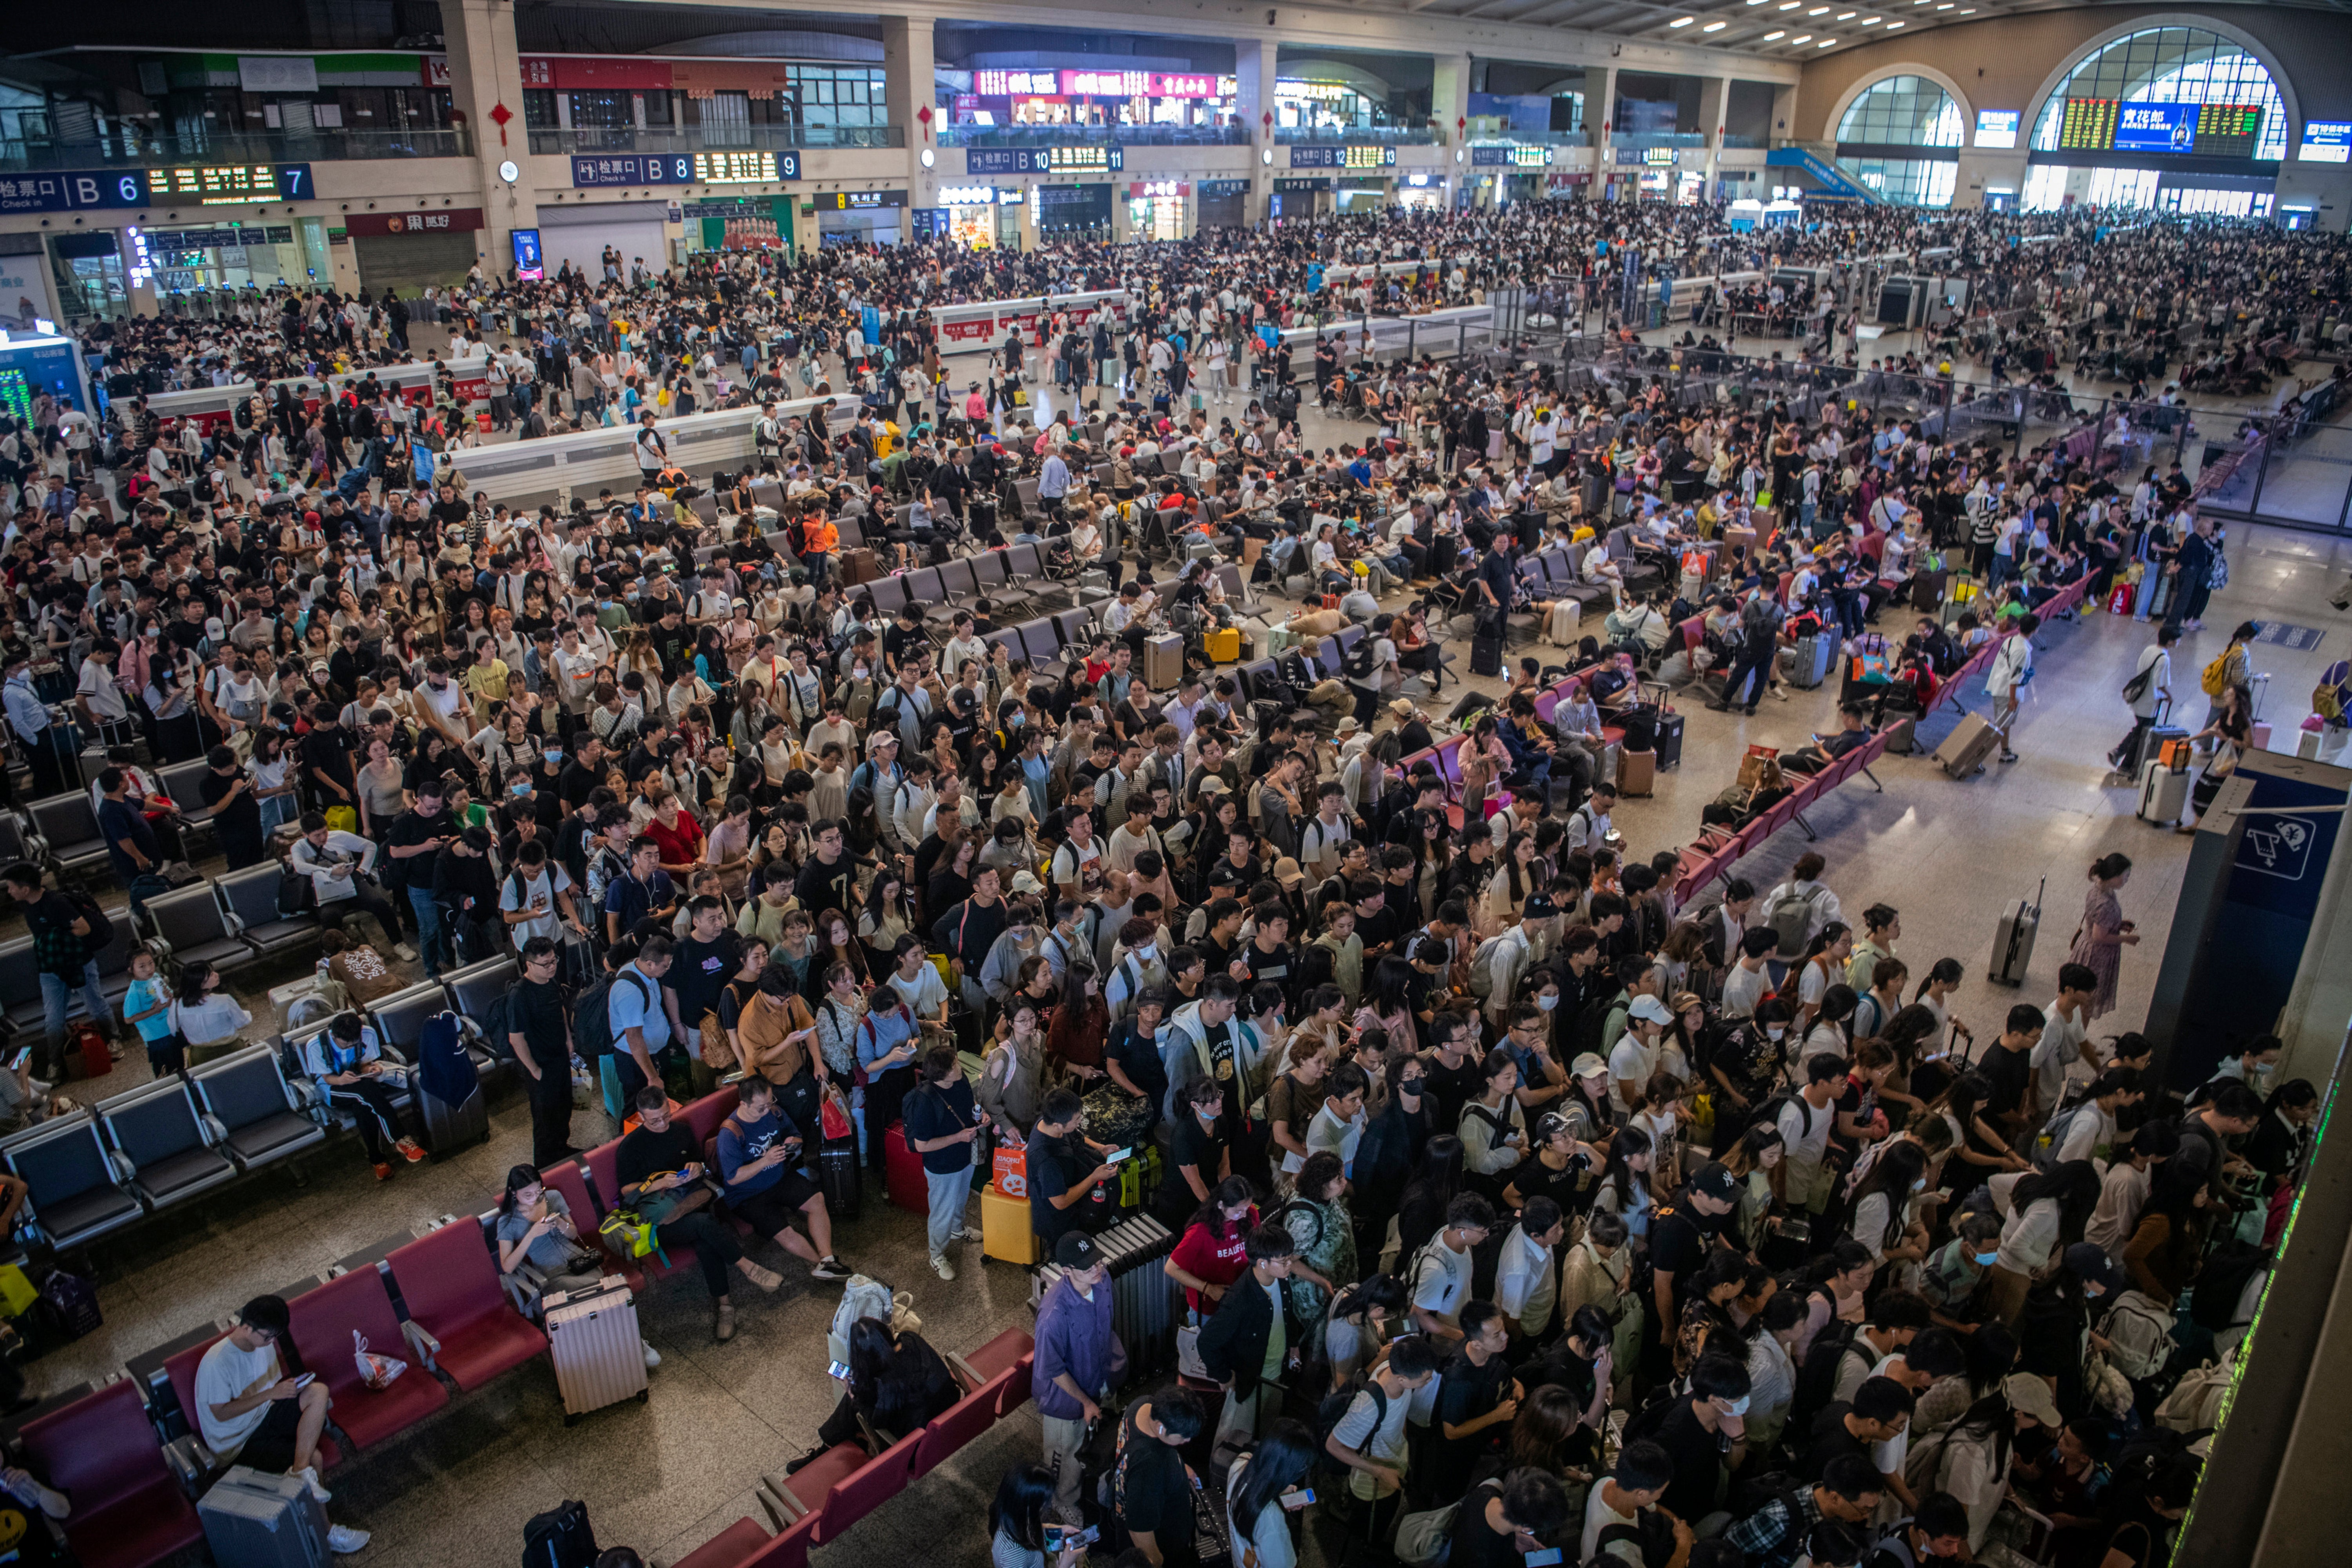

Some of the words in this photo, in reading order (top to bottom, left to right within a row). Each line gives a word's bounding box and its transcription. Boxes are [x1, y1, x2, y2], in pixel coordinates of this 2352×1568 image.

[2123, 109, 2164, 123] 青花郎
[985, 152, 1009, 164] 检票口
[1020, 152, 1028, 169] B
[1035, 152, 1049, 170] 10
[1111, 151, 1121, 168] 11
[1336, 150, 1345, 164] 12
[1386, 150, 1395, 164] 13
[1506, 150, 1514, 163] 14
[1545, 150, 1552, 163] 15
[599, 160, 635, 174] 检票口
[648, 159, 663, 180] B
[676, 158, 688, 179] 8
[784, 156, 795, 176] 9
[286, 170, 302, 194] 7
[1216, 181, 1243, 192] 特产超市
[1285, 180, 1312, 190] 特产超市
[1581, 176, 1590, 185] KFC
[0, 180, 55, 198] 检票口
[76, 178, 100, 203] B
[119, 176, 138, 201] 6
[850, 192, 882, 202] 便利店
[2, 200, 31, 209] Check
[667, 639, 679, 659] F
[1214, 1042, 1222, 1053] NOT
[996, 1155, 1020, 1164] XIAOHU
[1722, 1170, 1735, 1187] NY
[1078, 1240, 1089, 1252] NY
[1217, 1241, 1246, 1258] BEAUFIT
